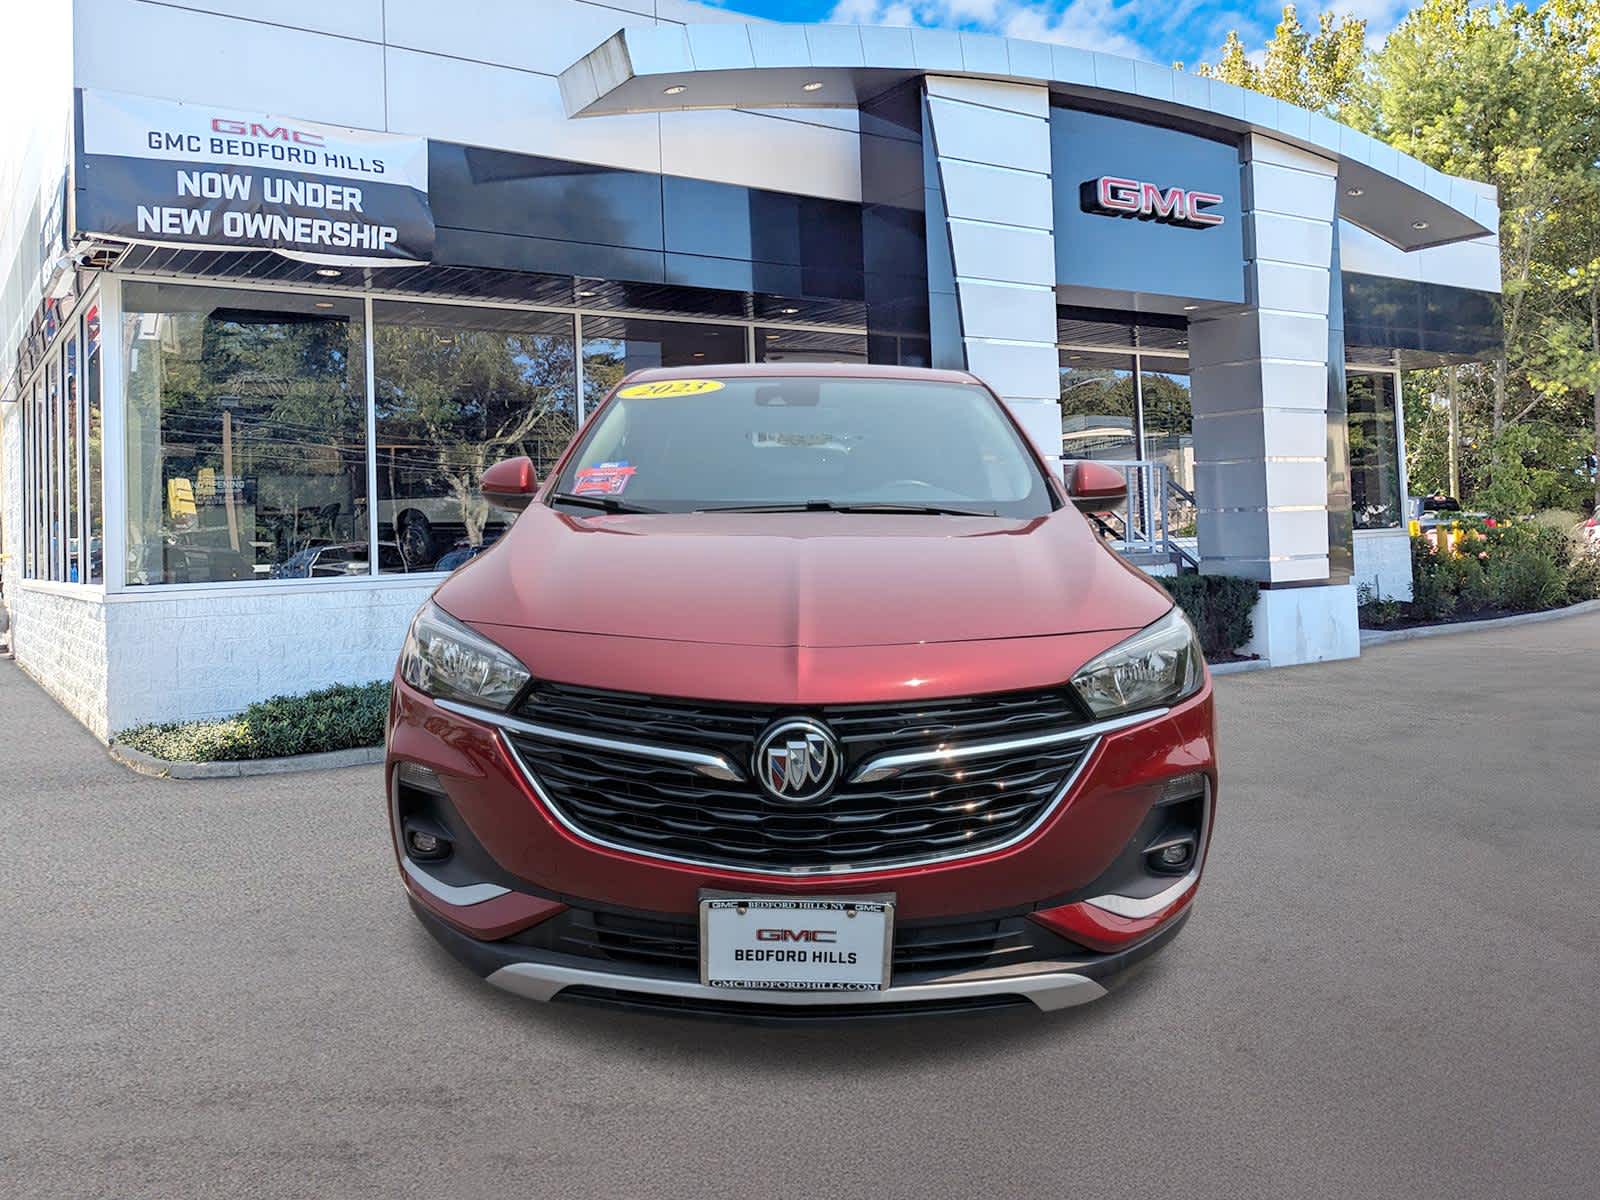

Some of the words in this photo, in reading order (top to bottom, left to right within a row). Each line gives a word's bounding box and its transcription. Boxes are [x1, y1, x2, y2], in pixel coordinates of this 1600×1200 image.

[211, 117, 326, 148] GMC
[148, 131, 200, 152] GMC
[210, 138, 316, 165] BEDFORD
[325, 153, 385, 174] HILLS
[176, 170, 252, 201] NOW
[263, 176, 364, 213] UNDER
[1098, 175, 1224, 225] GMC
[136, 205, 212, 236] NEW
[223, 211, 398, 250] OWNERSHIP
[748, 901, 798, 910] BEDFORD
[799, 902, 829, 910] HILLS
[854, 904, 882, 912] GMC
[756, 928, 837, 943] GMC
[735, 949, 807, 963] BEDFORD
[812, 951, 857, 964] HILLS
[711, 979, 879, 991] GMCBEDFORDHILLS.COM
